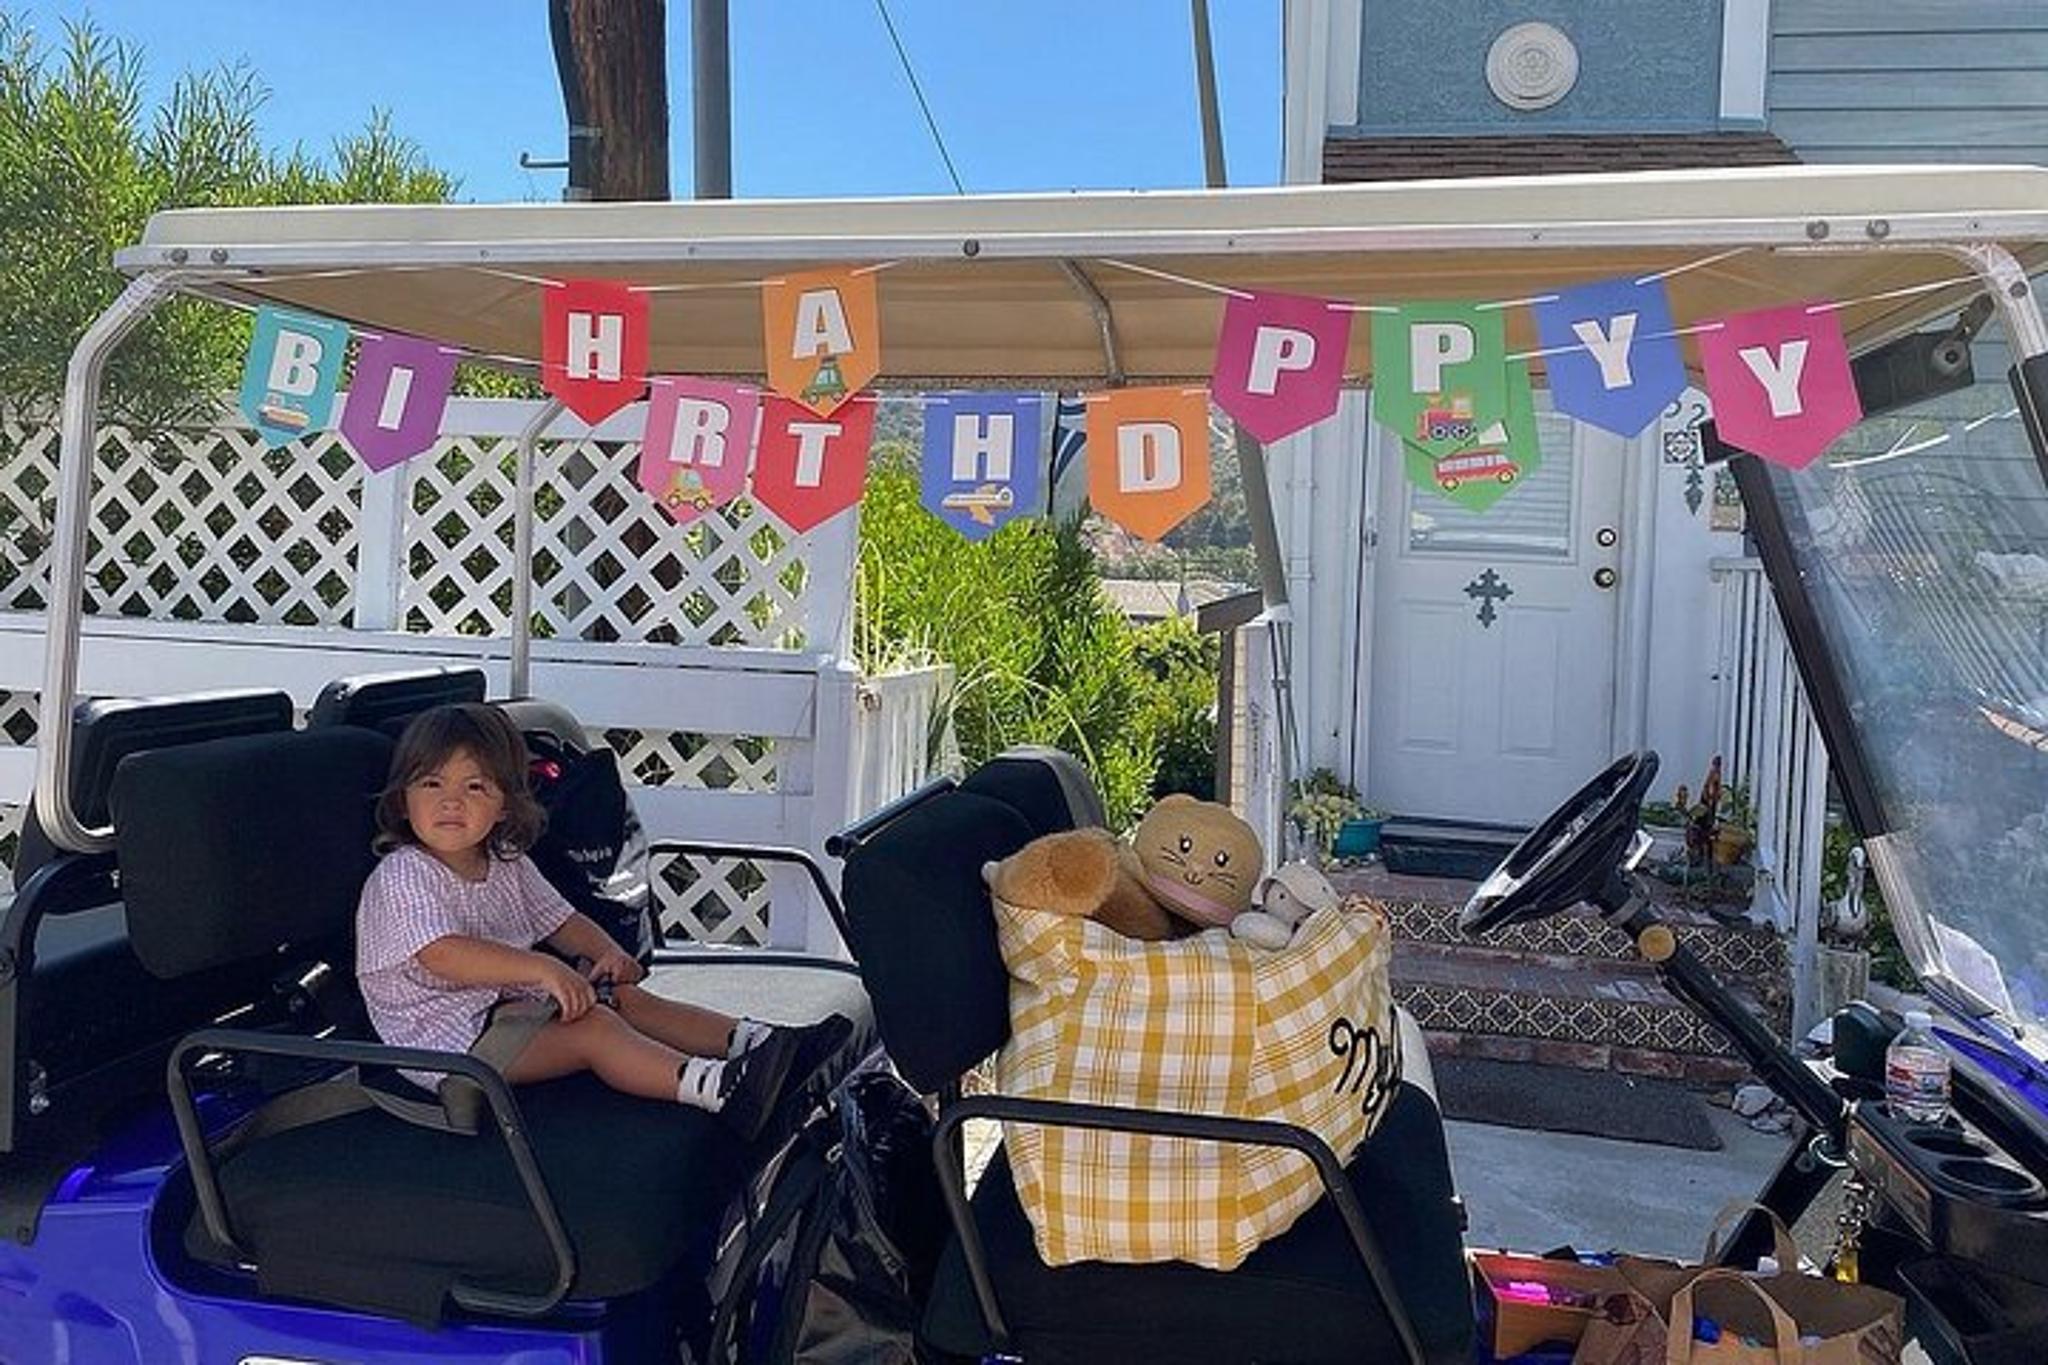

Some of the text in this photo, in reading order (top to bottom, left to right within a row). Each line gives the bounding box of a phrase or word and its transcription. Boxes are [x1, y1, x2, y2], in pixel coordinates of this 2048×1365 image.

[568, 288, 1638, 395] H A P P Y
[270, 330, 1809, 493] B I R T H D Y
